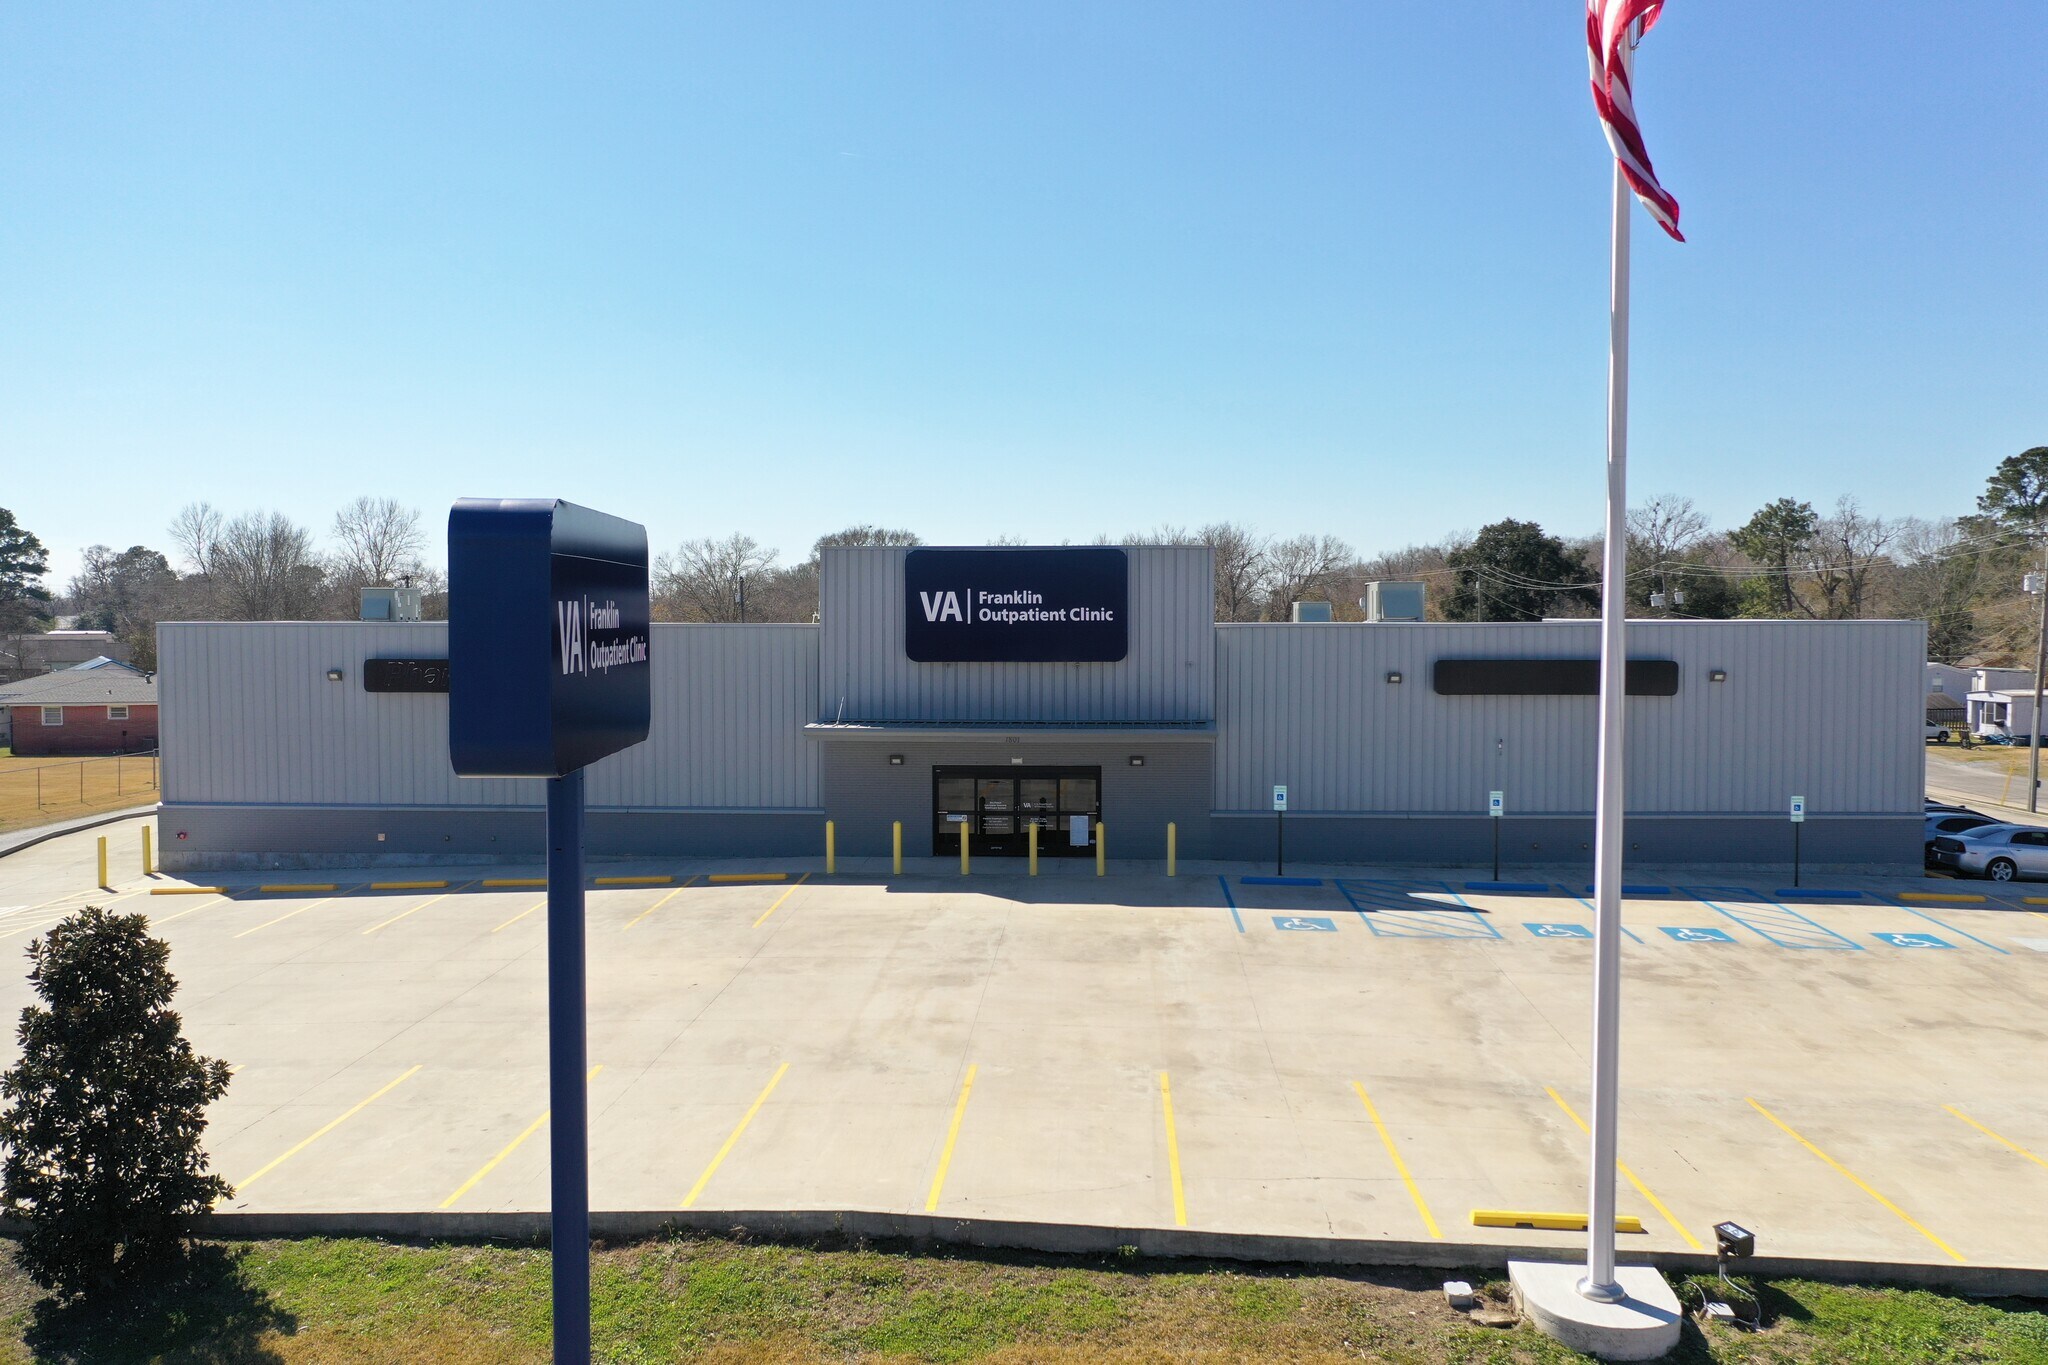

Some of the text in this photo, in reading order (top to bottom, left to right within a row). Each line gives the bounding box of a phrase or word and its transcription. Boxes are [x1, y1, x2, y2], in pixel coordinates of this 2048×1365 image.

[920, 591, 963, 622] VA
[979, 590, 1042, 604] Franklin
[590, 600, 620, 630] Franklin
[978, 607, 1114, 625] Outpatient Clinic
[558, 600, 583, 675] VA
[590, 635, 647, 675] Outpatient Clinic
